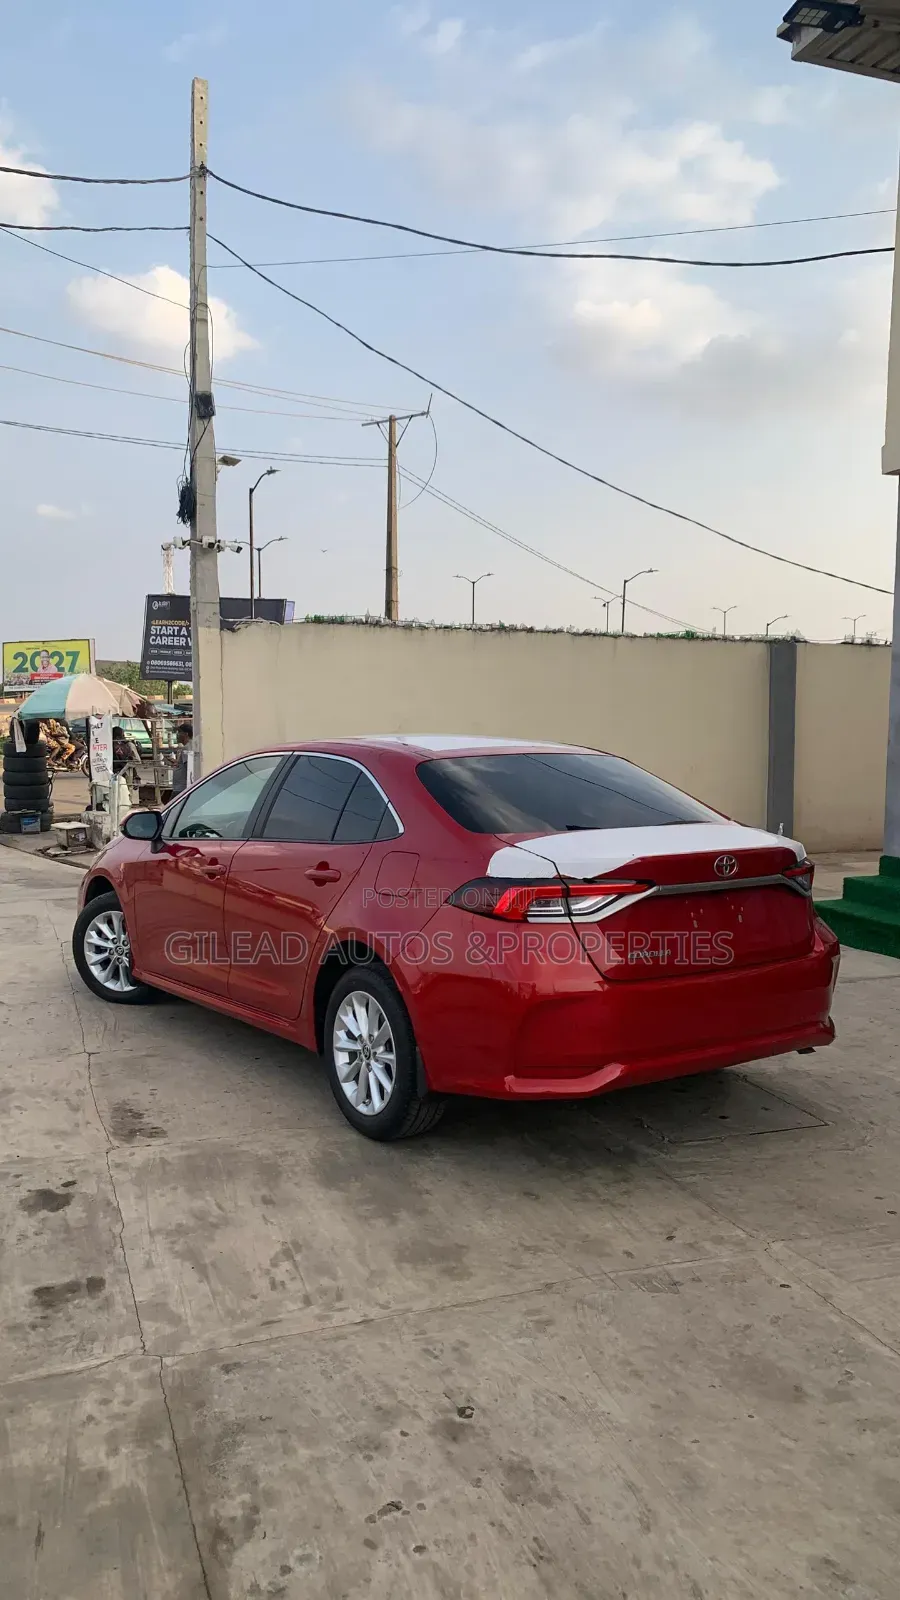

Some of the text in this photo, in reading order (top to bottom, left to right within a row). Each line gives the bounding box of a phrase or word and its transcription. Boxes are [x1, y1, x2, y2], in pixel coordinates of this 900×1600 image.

[150, 625, 188, 636] START A
[149, 635, 186, 646] CAREER
[12, 650, 81, 673] 2027
